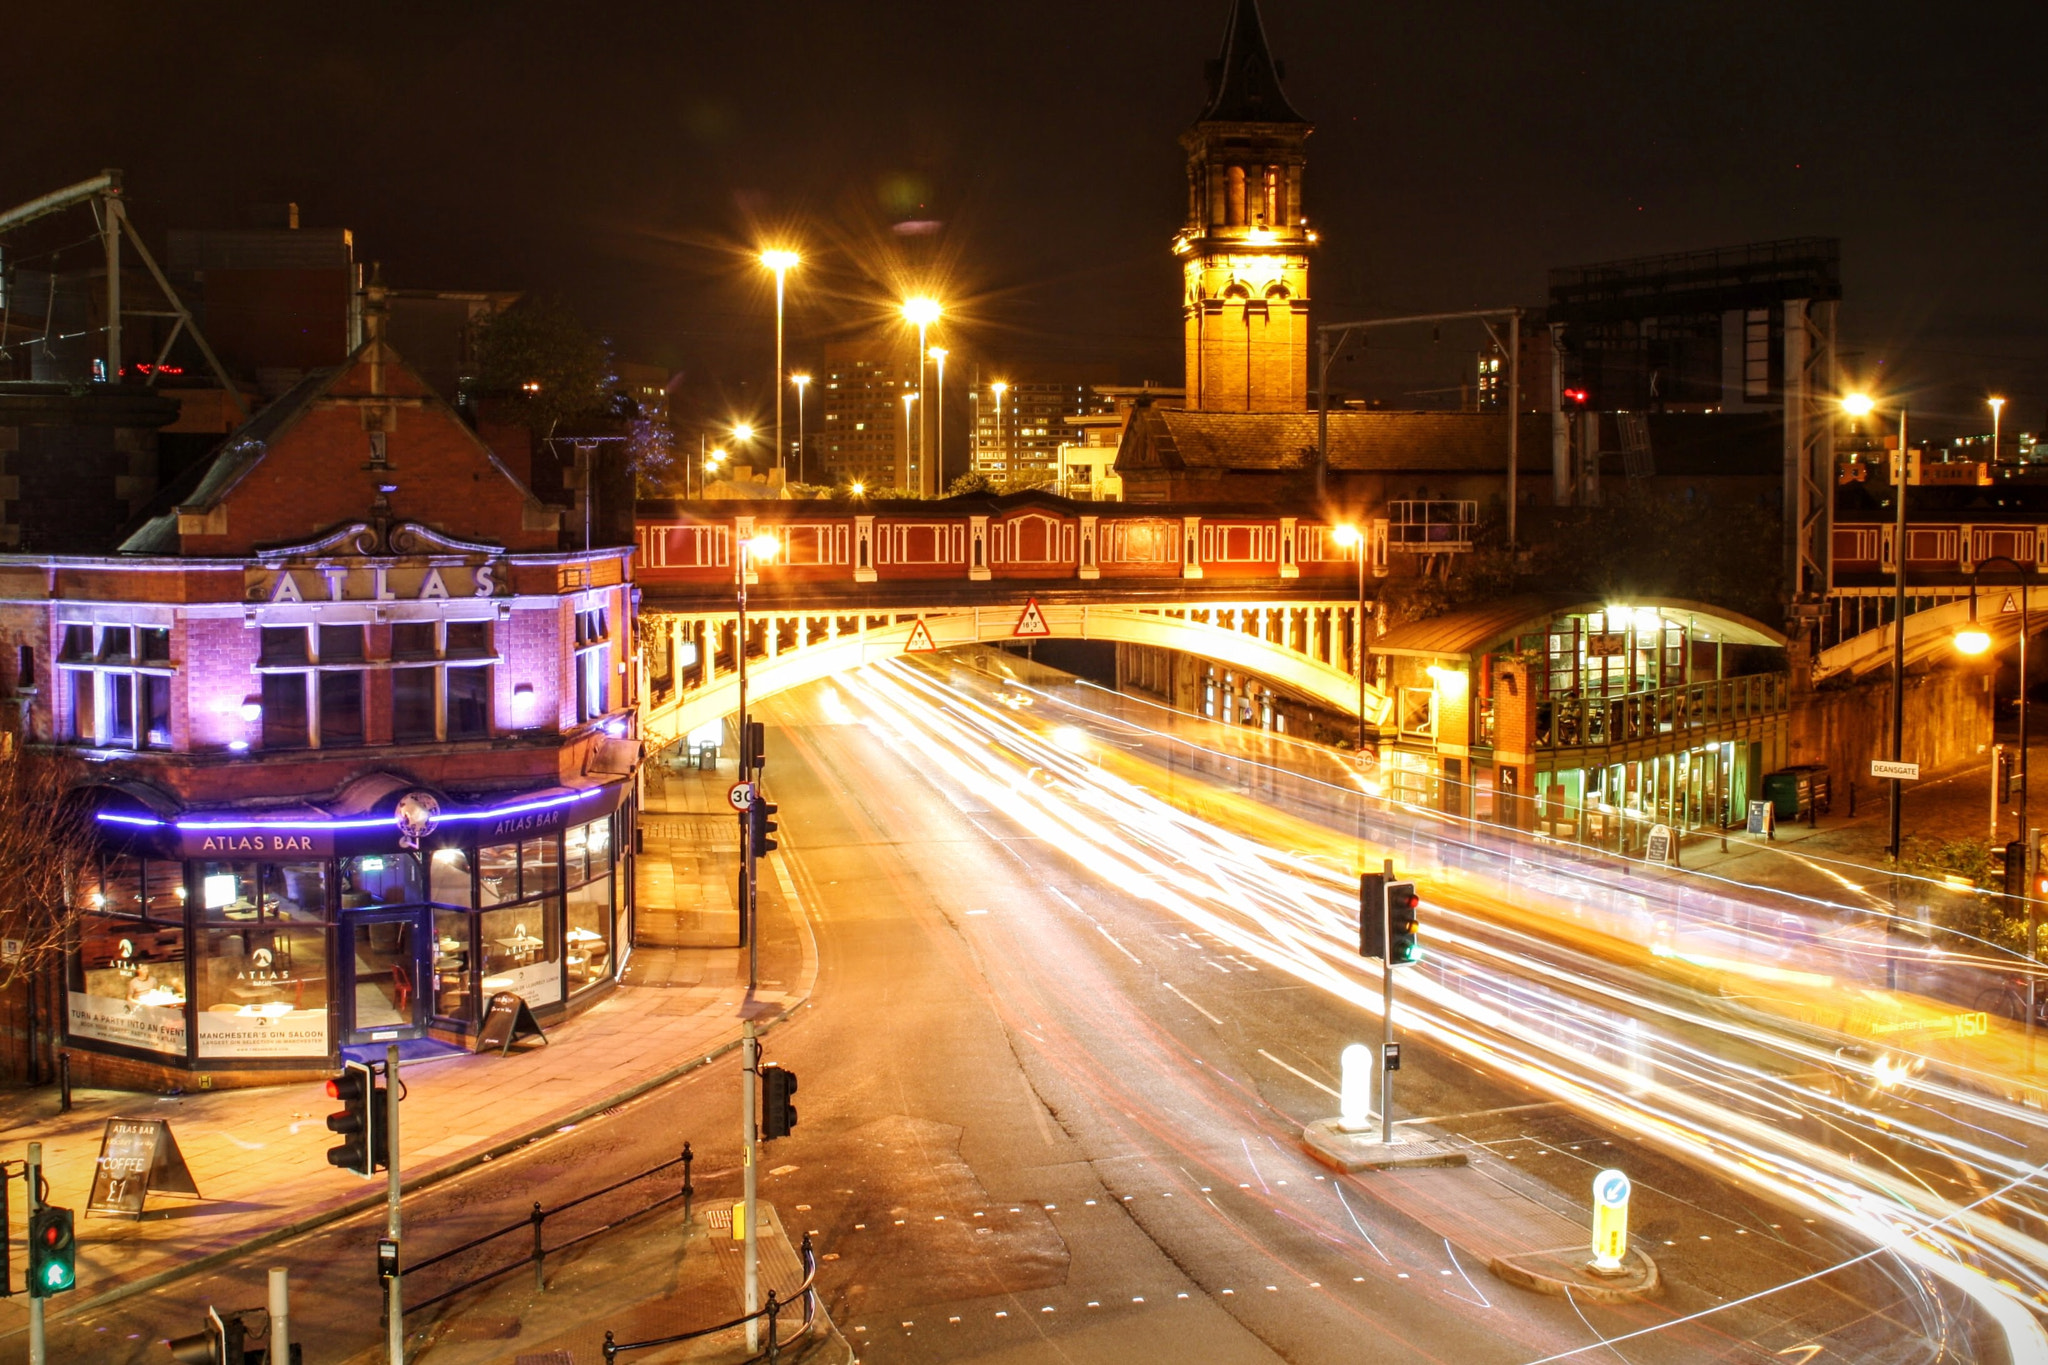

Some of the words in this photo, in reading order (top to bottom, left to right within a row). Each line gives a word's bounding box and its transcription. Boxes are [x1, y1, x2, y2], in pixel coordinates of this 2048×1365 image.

[272, 566, 494, 602] ATLAS
[1356, 755, 1372, 767] 30
[1873, 765, 1917, 776] DEANSGATE
[494, 815, 532, 835] ATLAS
[536, 810, 559, 828] BAR
[203, 836, 265, 850] ATLAS
[273, 836, 312, 850] BAR
[237, 970, 289, 979] ATLAS
[71, 1009, 91, 1020] TURN
[93, 1014, 99, 1022] A
[101, 1015, 124, 1026] PARTY
[127, 1020, 146, 1030] INTO
[147, 1023, 158, 1033] AN
[160, 1026, 185, 1038] EVENT
[1955, 1012, 1987, 1038] X50
[288, 1030, 324, 1038] SALOON
[113, 1125, 137, 1134] ATLAS
[139, 1126, 154, 1135] BAR
[102, 1157, 145, 1173] COFFEE
[106, 1180, 127, 1203] £1
